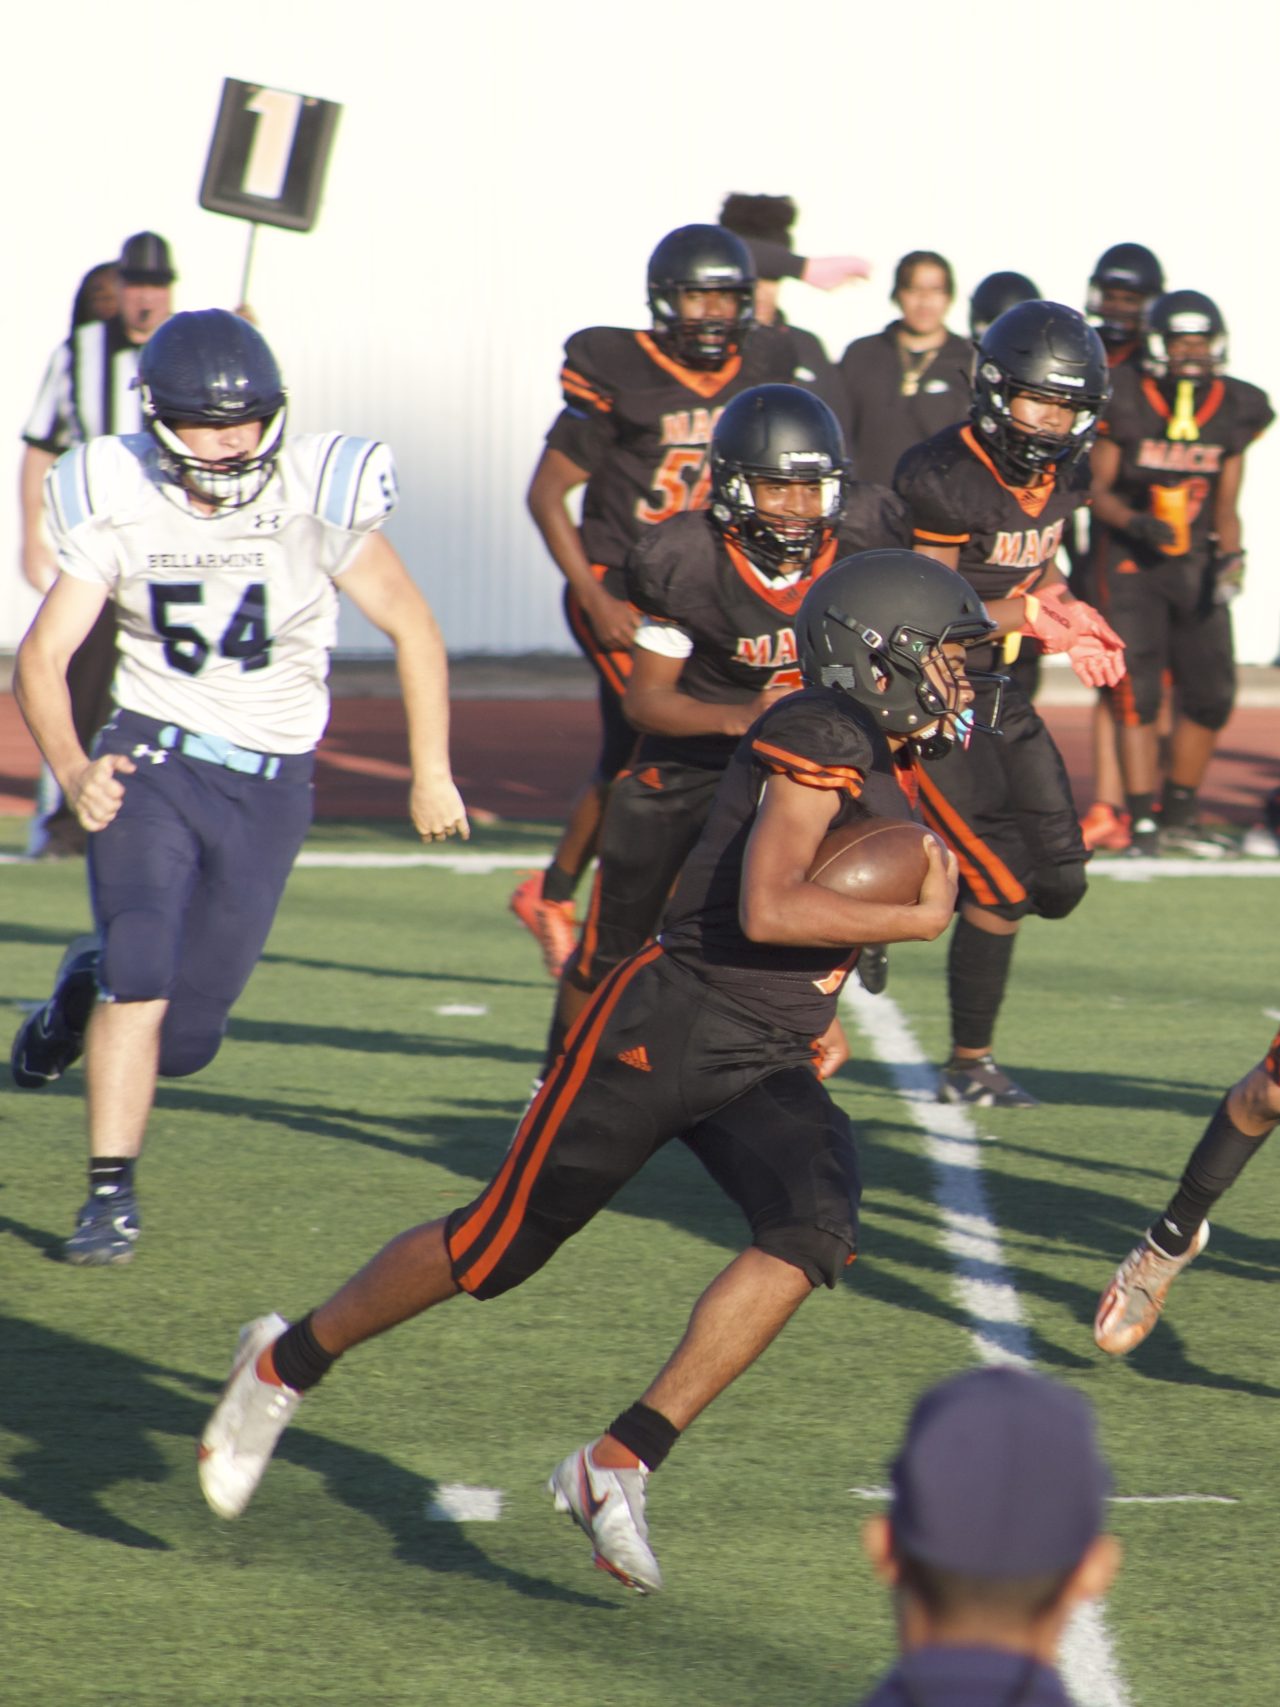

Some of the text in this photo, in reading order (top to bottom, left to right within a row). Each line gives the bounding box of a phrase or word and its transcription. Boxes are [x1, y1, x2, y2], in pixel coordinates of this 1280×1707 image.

[243, 86, 303, 200] 1
[660, 406, 725, 445] MA
[1137, 439, 1224, 472] MACK
[147, 553, 266, 568] BELLARMINE
[147, 580, 275, 678] 54
[731, 627, 798, 667] MA
